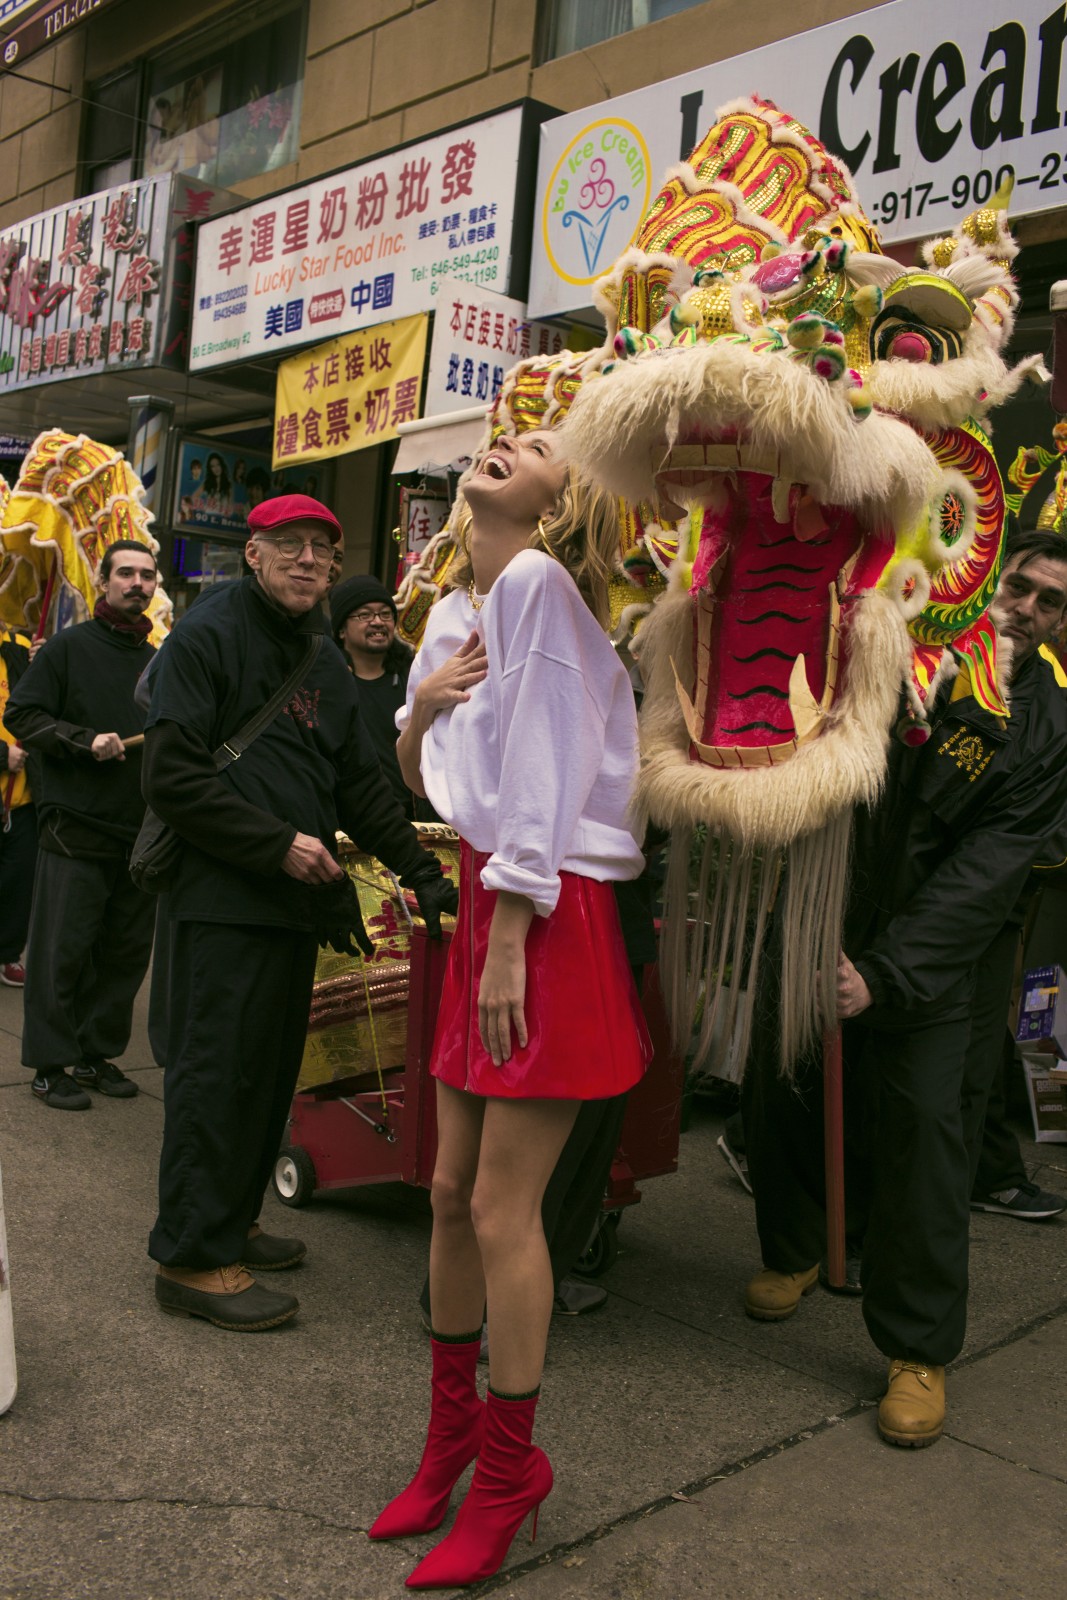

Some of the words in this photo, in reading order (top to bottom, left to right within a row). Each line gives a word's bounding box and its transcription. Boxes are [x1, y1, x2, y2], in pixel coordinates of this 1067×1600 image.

[600, 128, 646, 189] Cream
[217, 138, 478, 277] 幸運星奶粉批發
[253, 264, 298, 296] Lucky
[299, 252, 331, 282] Star
[332, 235, 375, 273] Food
[376, 231, 407, 266] Inc.
[411, 265, 429, 283] Tel:
[430, 245, 500, 278] 646-549-4240
[263, 297, 304, 340] 美國
[350, 272, 395, 315] 中國
[303, 337, 392, 395] 本店接收
